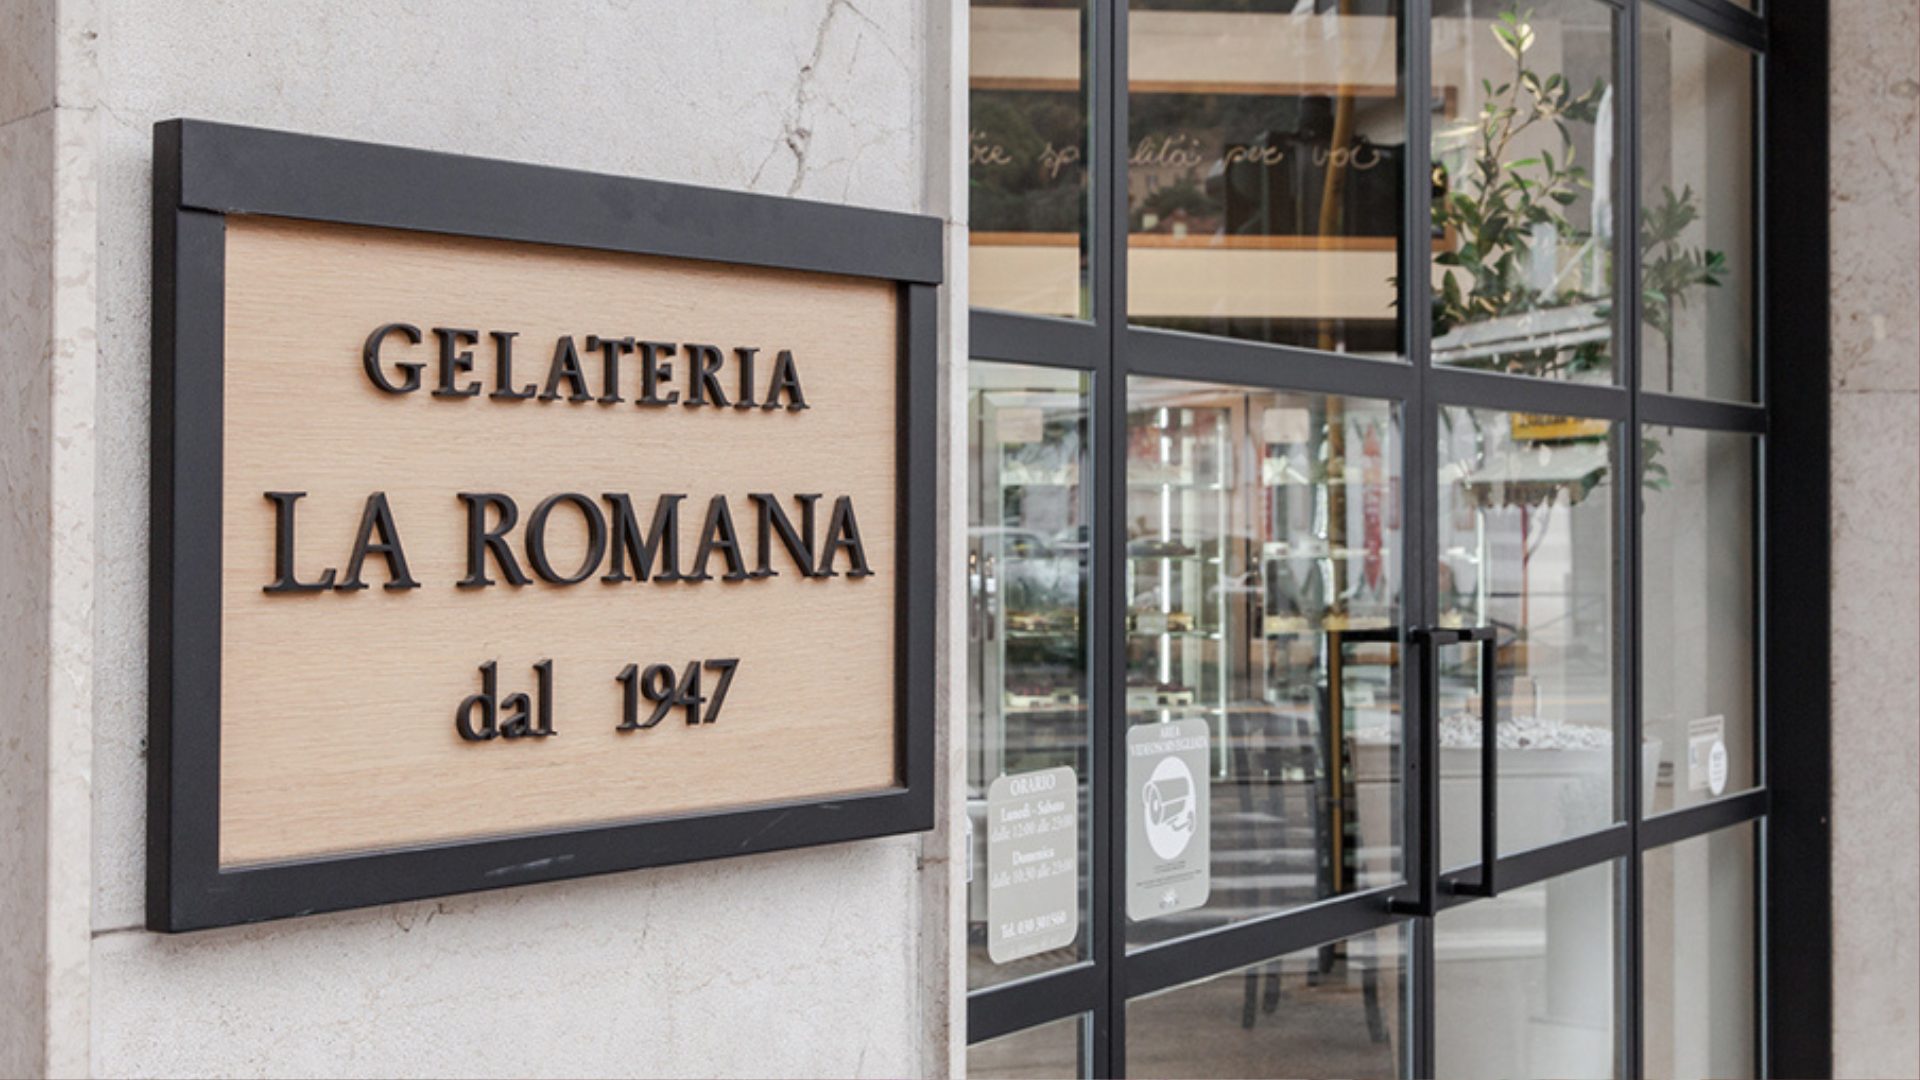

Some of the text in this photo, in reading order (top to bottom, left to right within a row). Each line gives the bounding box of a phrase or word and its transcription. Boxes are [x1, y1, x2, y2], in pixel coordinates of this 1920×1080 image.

[363, 323, 810, 411] GELATERIA
[263, 491, 874, 595] LA ROMANA
[456, 658, 740, 743] dal 1947
[1010, 774, 1056, 796] ORARIO
